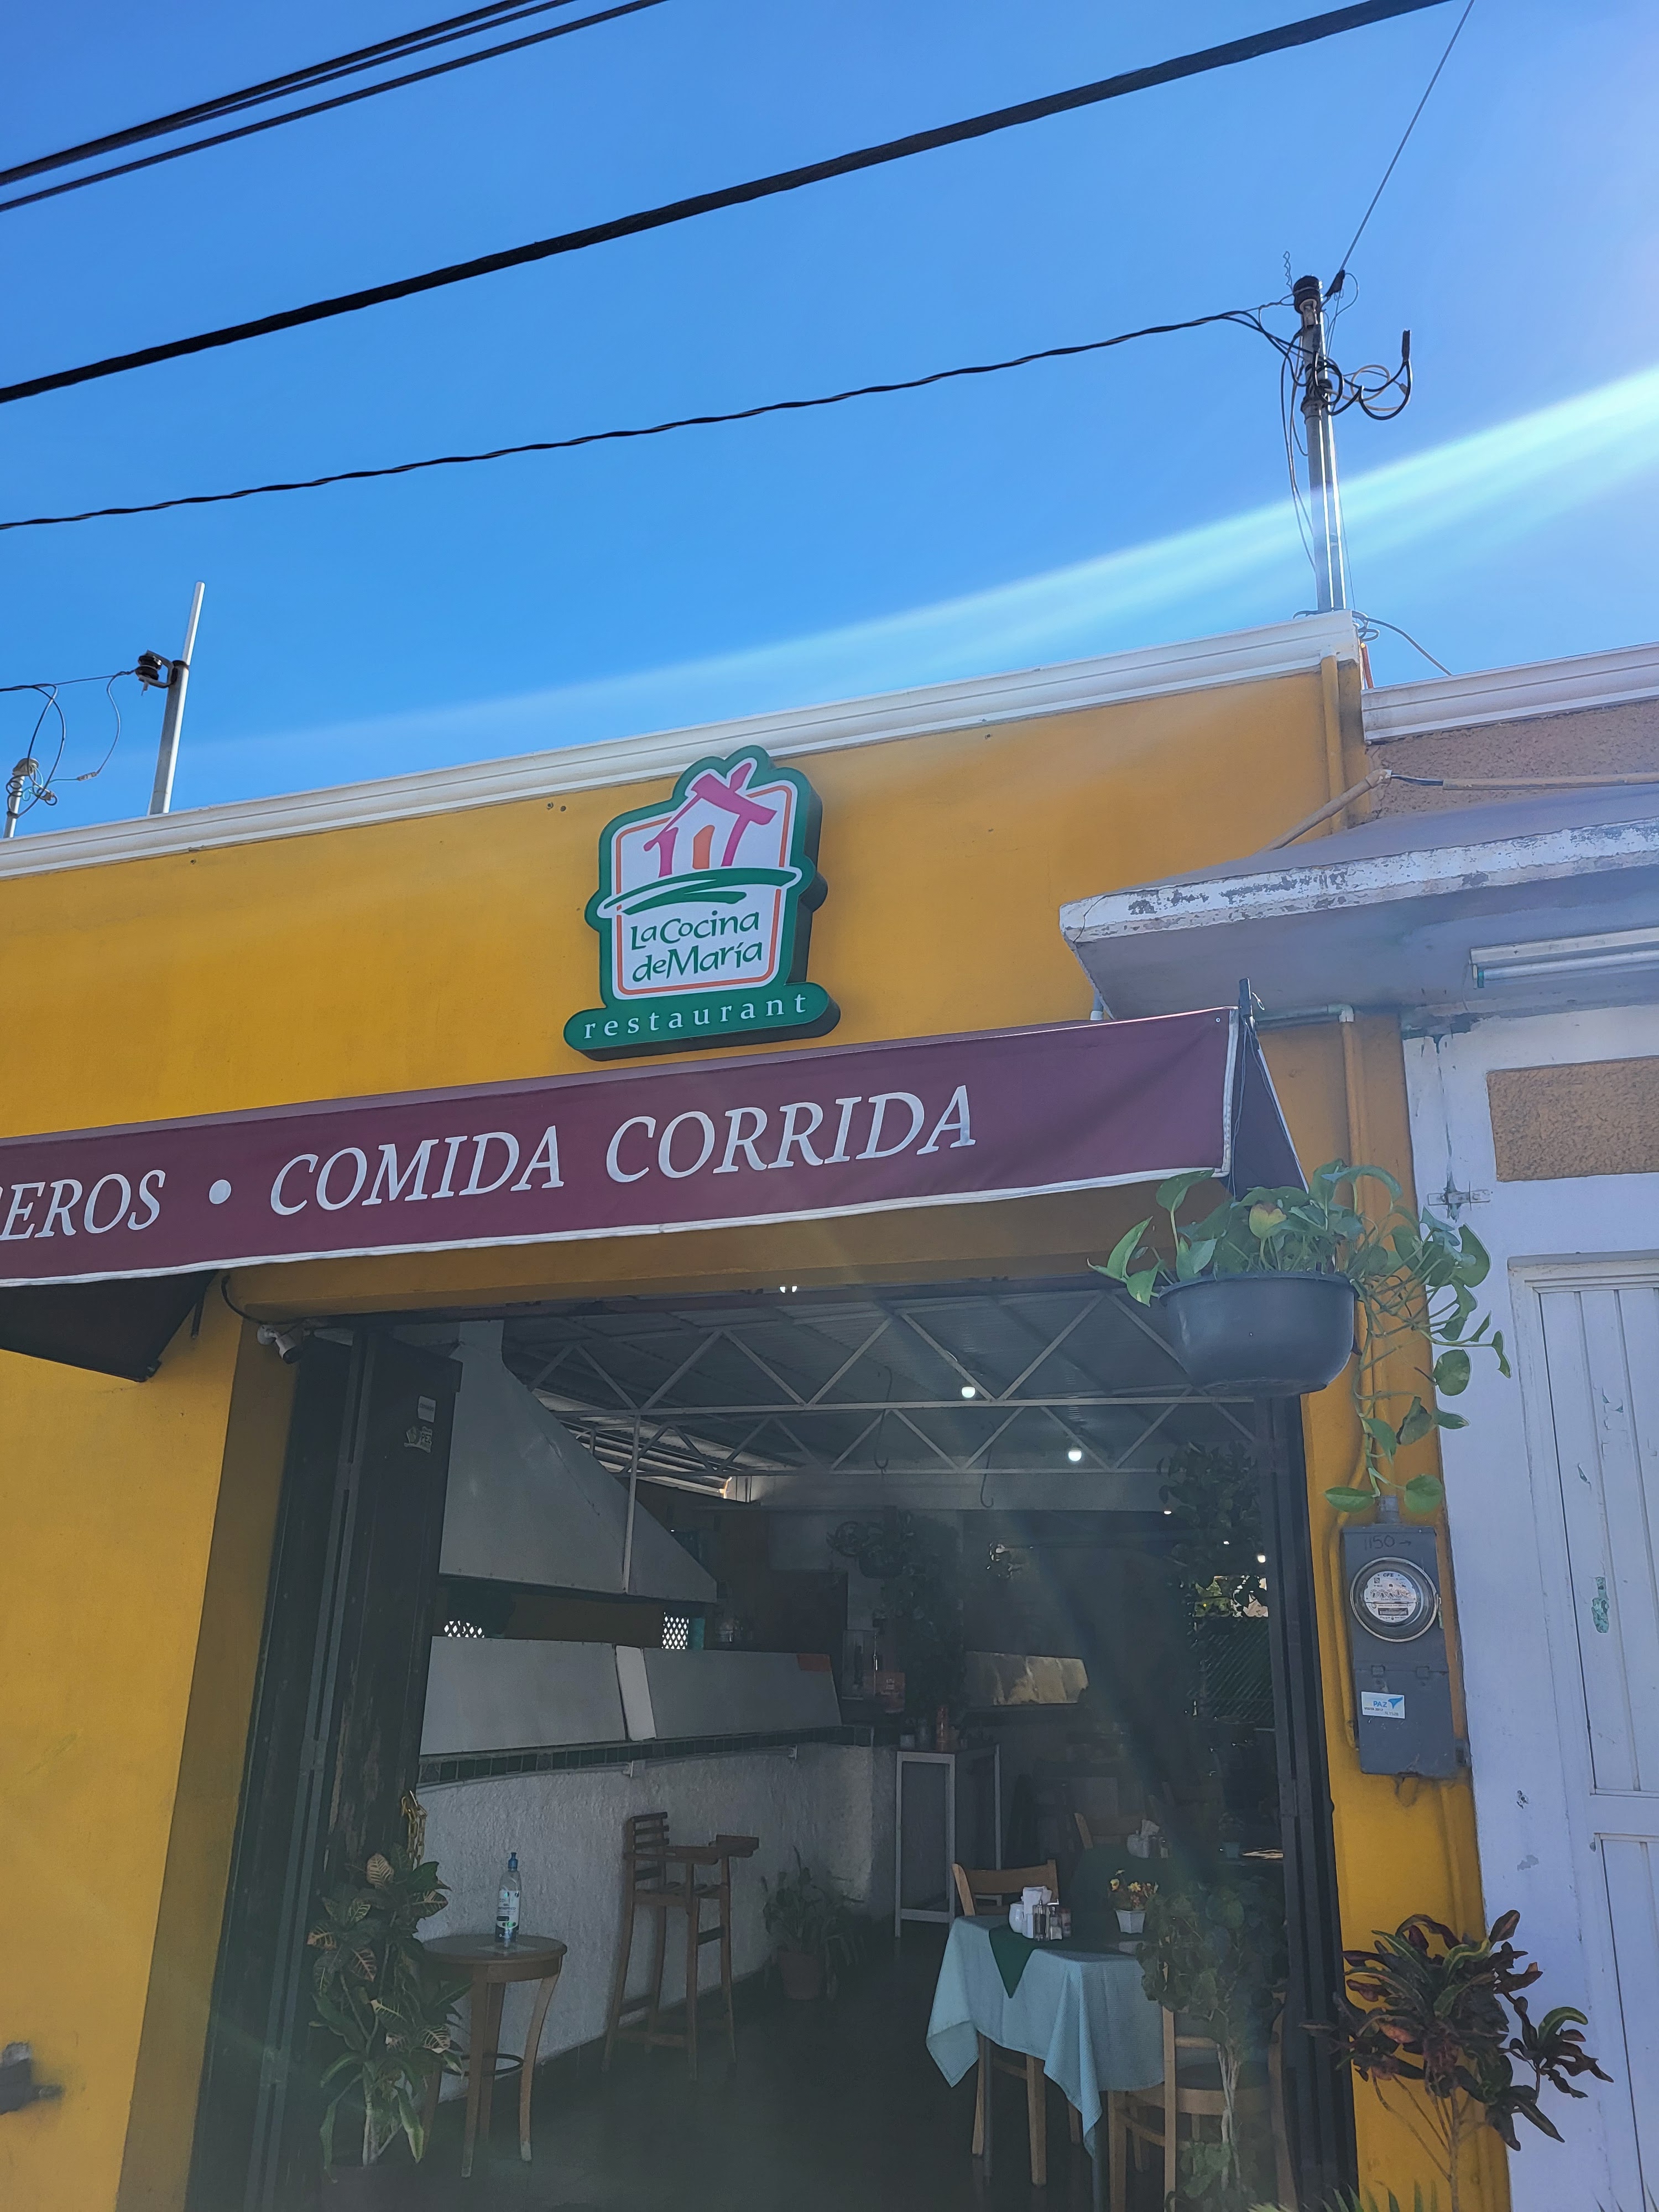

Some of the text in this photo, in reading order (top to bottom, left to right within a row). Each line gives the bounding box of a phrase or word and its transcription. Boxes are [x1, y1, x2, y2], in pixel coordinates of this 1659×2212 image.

[583, 994, 807, 1040] restaurant
[0, 1084, 977, 1241] EROS COMIDA CORRIDA
